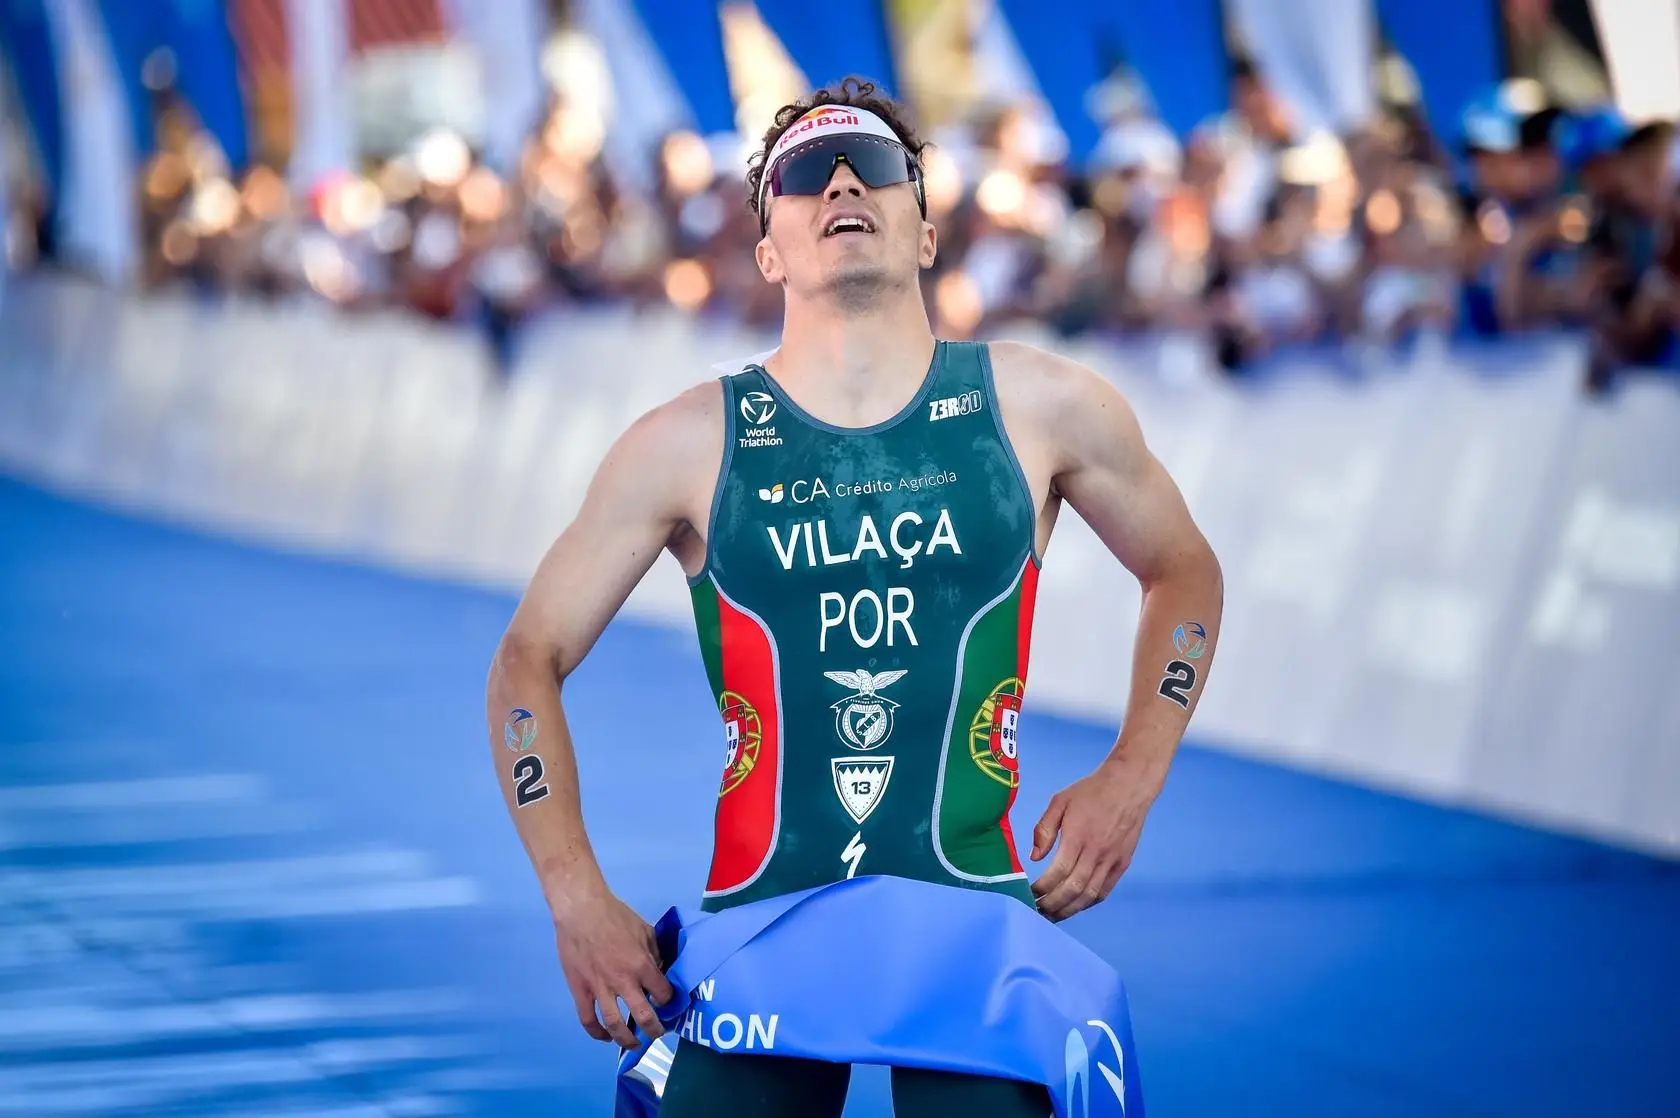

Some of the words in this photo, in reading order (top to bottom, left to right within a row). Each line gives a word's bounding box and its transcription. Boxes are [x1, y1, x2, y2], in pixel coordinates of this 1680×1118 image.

[780, 121, 814, 149] Red
[817, 115, 859, 126] Bull
[739, 437, 783, 448] Triathlon
[745, 426, 775, 437] World
[791, 477, 830, 503] CA
[835, 482, 892, 497] Crédito
[766, 509, 963, 570] VILAÇA
[819, 587, 919, 652] POR
[1157, 659, 1197, 710] 2
[512, 754, 551, 808] 2
[851, 781, 871, 795] 13
[675, 1009, 779, 1050] HLON
